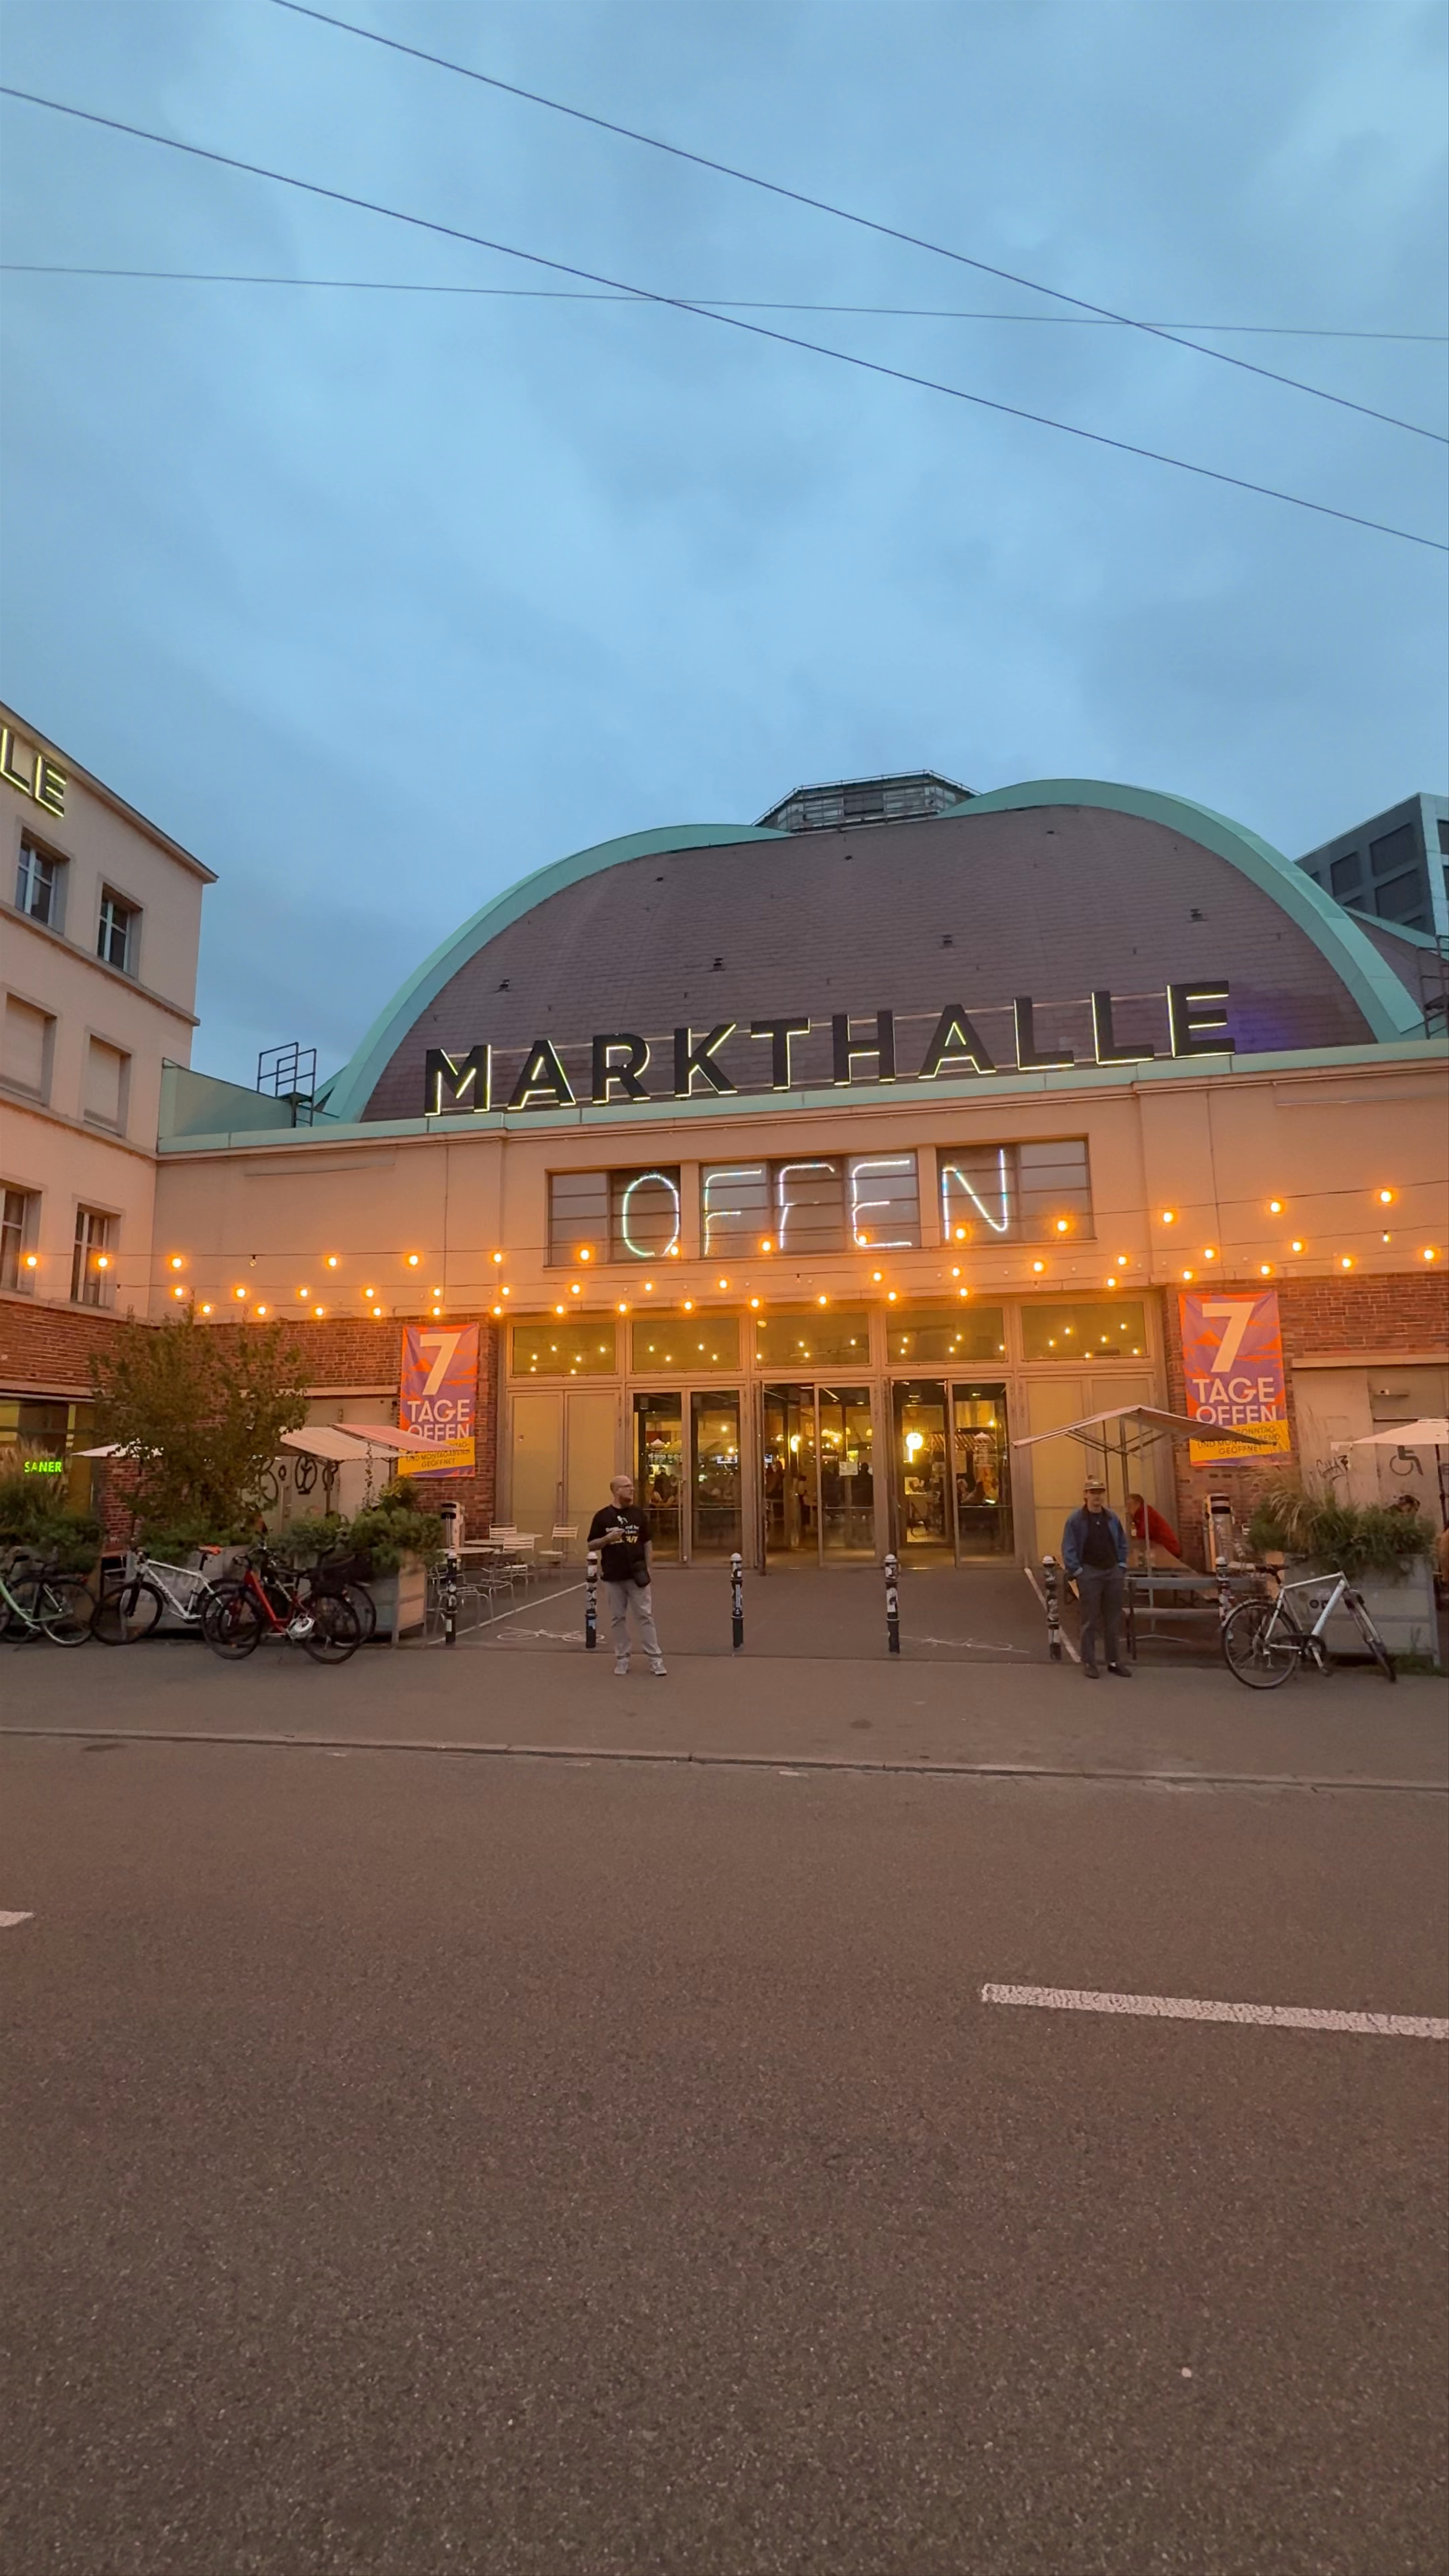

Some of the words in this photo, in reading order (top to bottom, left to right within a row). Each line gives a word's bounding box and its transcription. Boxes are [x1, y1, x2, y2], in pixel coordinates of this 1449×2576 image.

[424, 980, 1236, 1117] MARKTHALLE
[623, 1149, 1009, 1257] OFFEN
[1202, 1301, 1255, 1373] 7
[420, 1333, 461, 1396] 7
[407, 1399, 470, 1423] TAGE
[1192, 1377, 1275, 1404] TAGE
[1195, 1405, 1277, 1426] OFFEN
[24, 1461, 62, 1472] SANER
